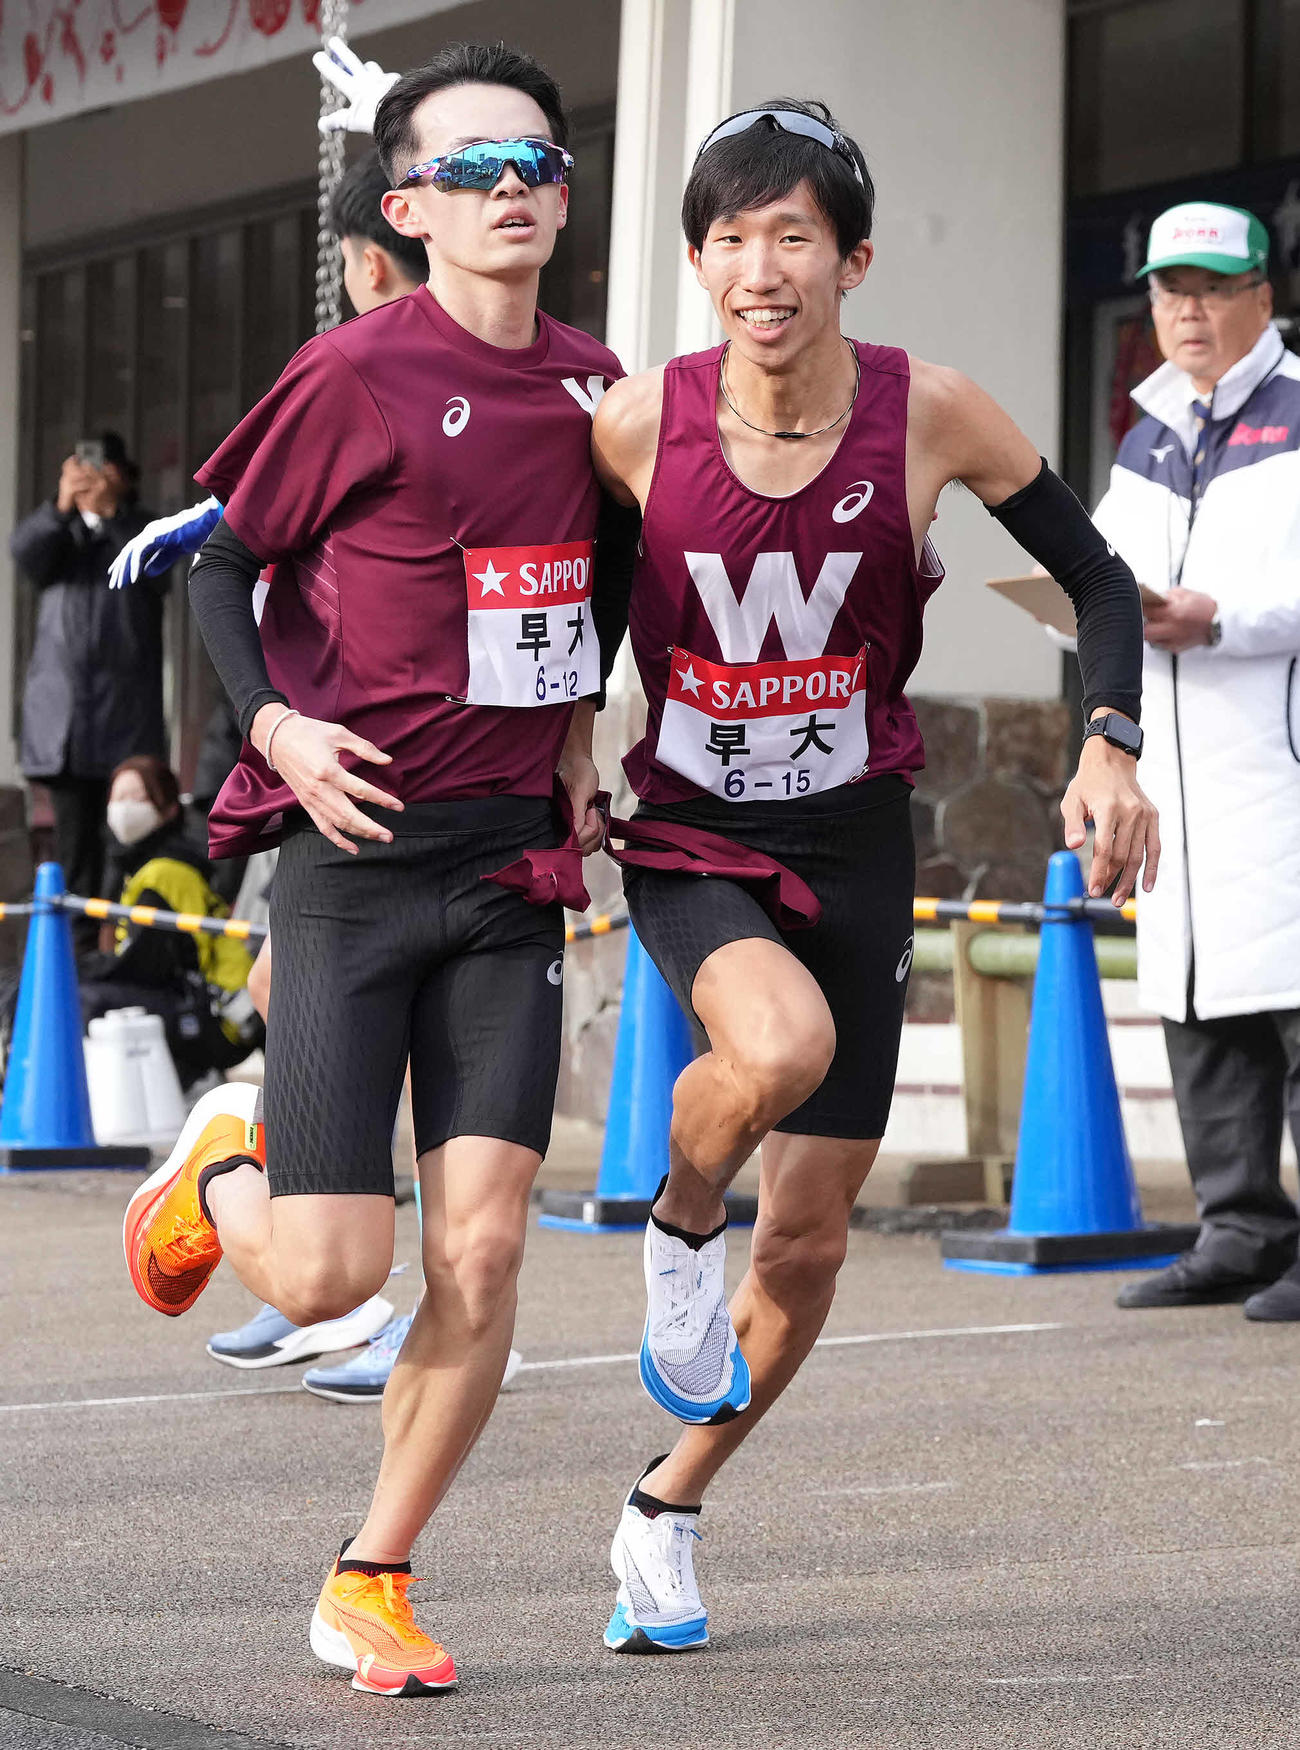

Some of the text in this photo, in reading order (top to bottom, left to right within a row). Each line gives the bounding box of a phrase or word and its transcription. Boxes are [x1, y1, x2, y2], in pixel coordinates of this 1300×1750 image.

[519, 557, 591, 596] SAPPO
[683, 551, 864, 663] W
[536, 666, 578, 701] 6-12
[724, 769, 811, 798] 6-15
